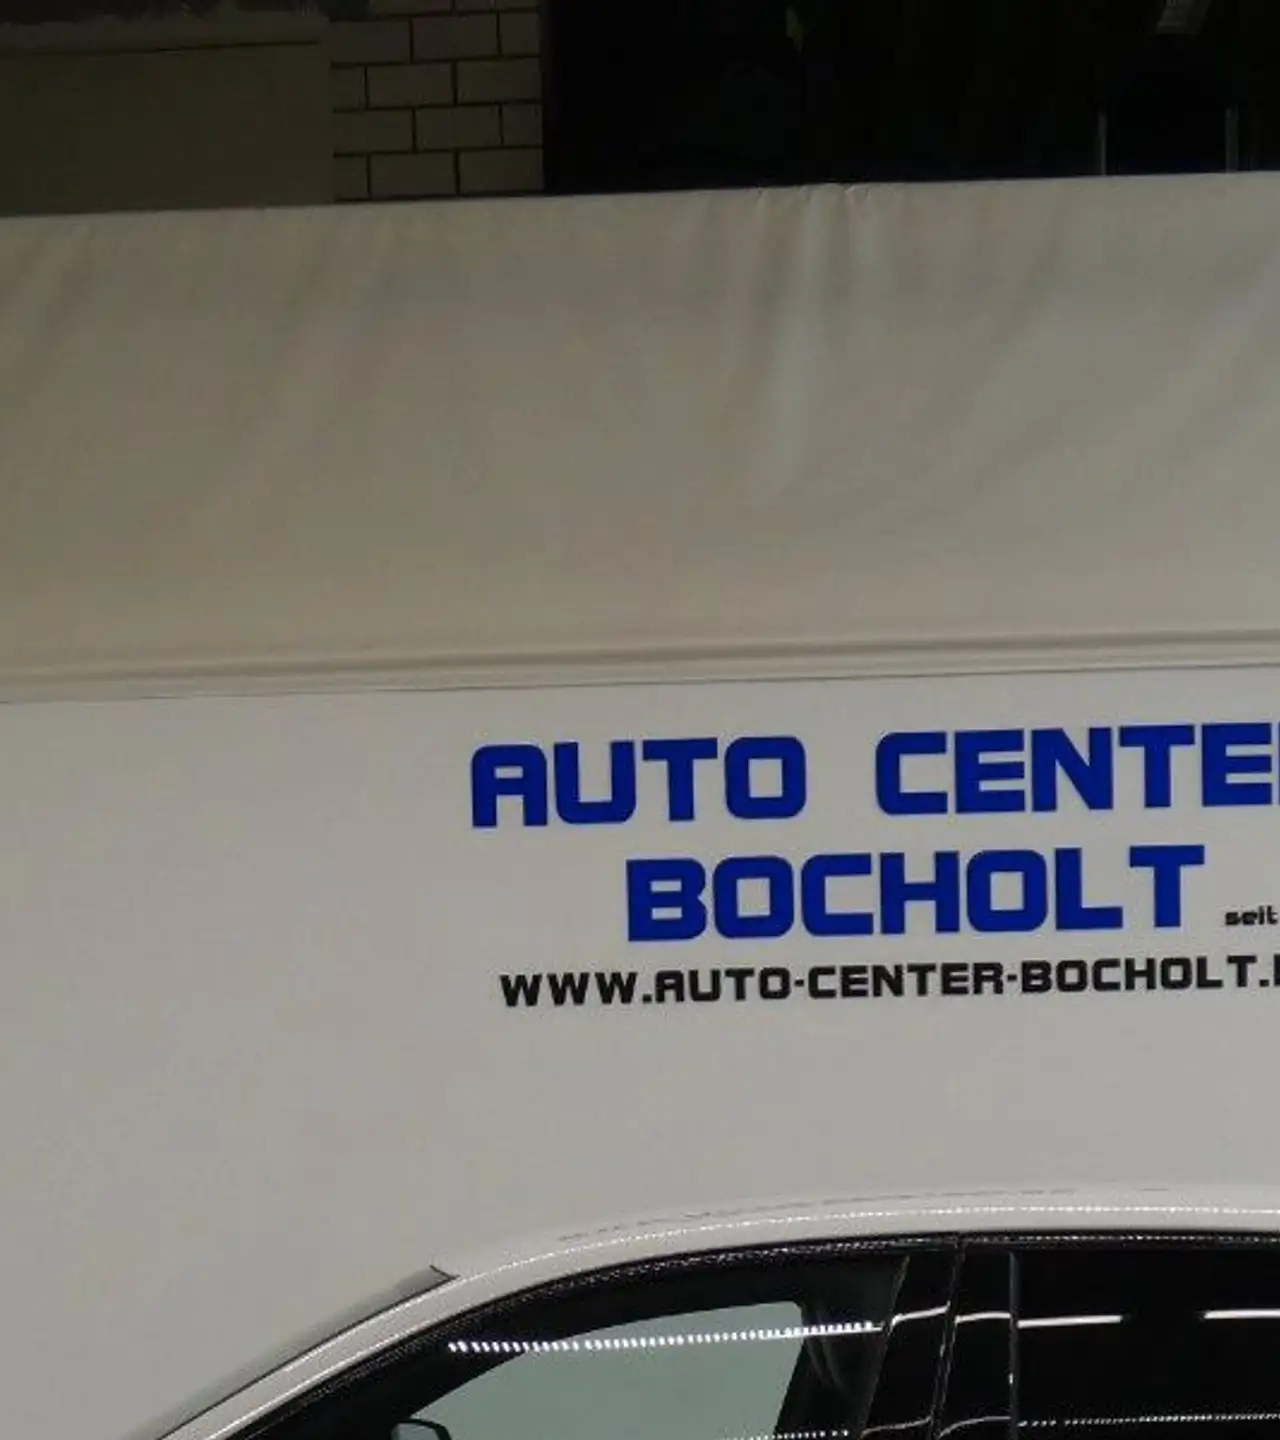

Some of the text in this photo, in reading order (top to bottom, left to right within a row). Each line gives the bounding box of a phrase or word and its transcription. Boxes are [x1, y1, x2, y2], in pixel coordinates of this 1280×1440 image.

[469, 734, 808, 830] AUTO
[624, 843, 1207, 944] BOCHOLT
[1223, 902, 1279, 928] seit
